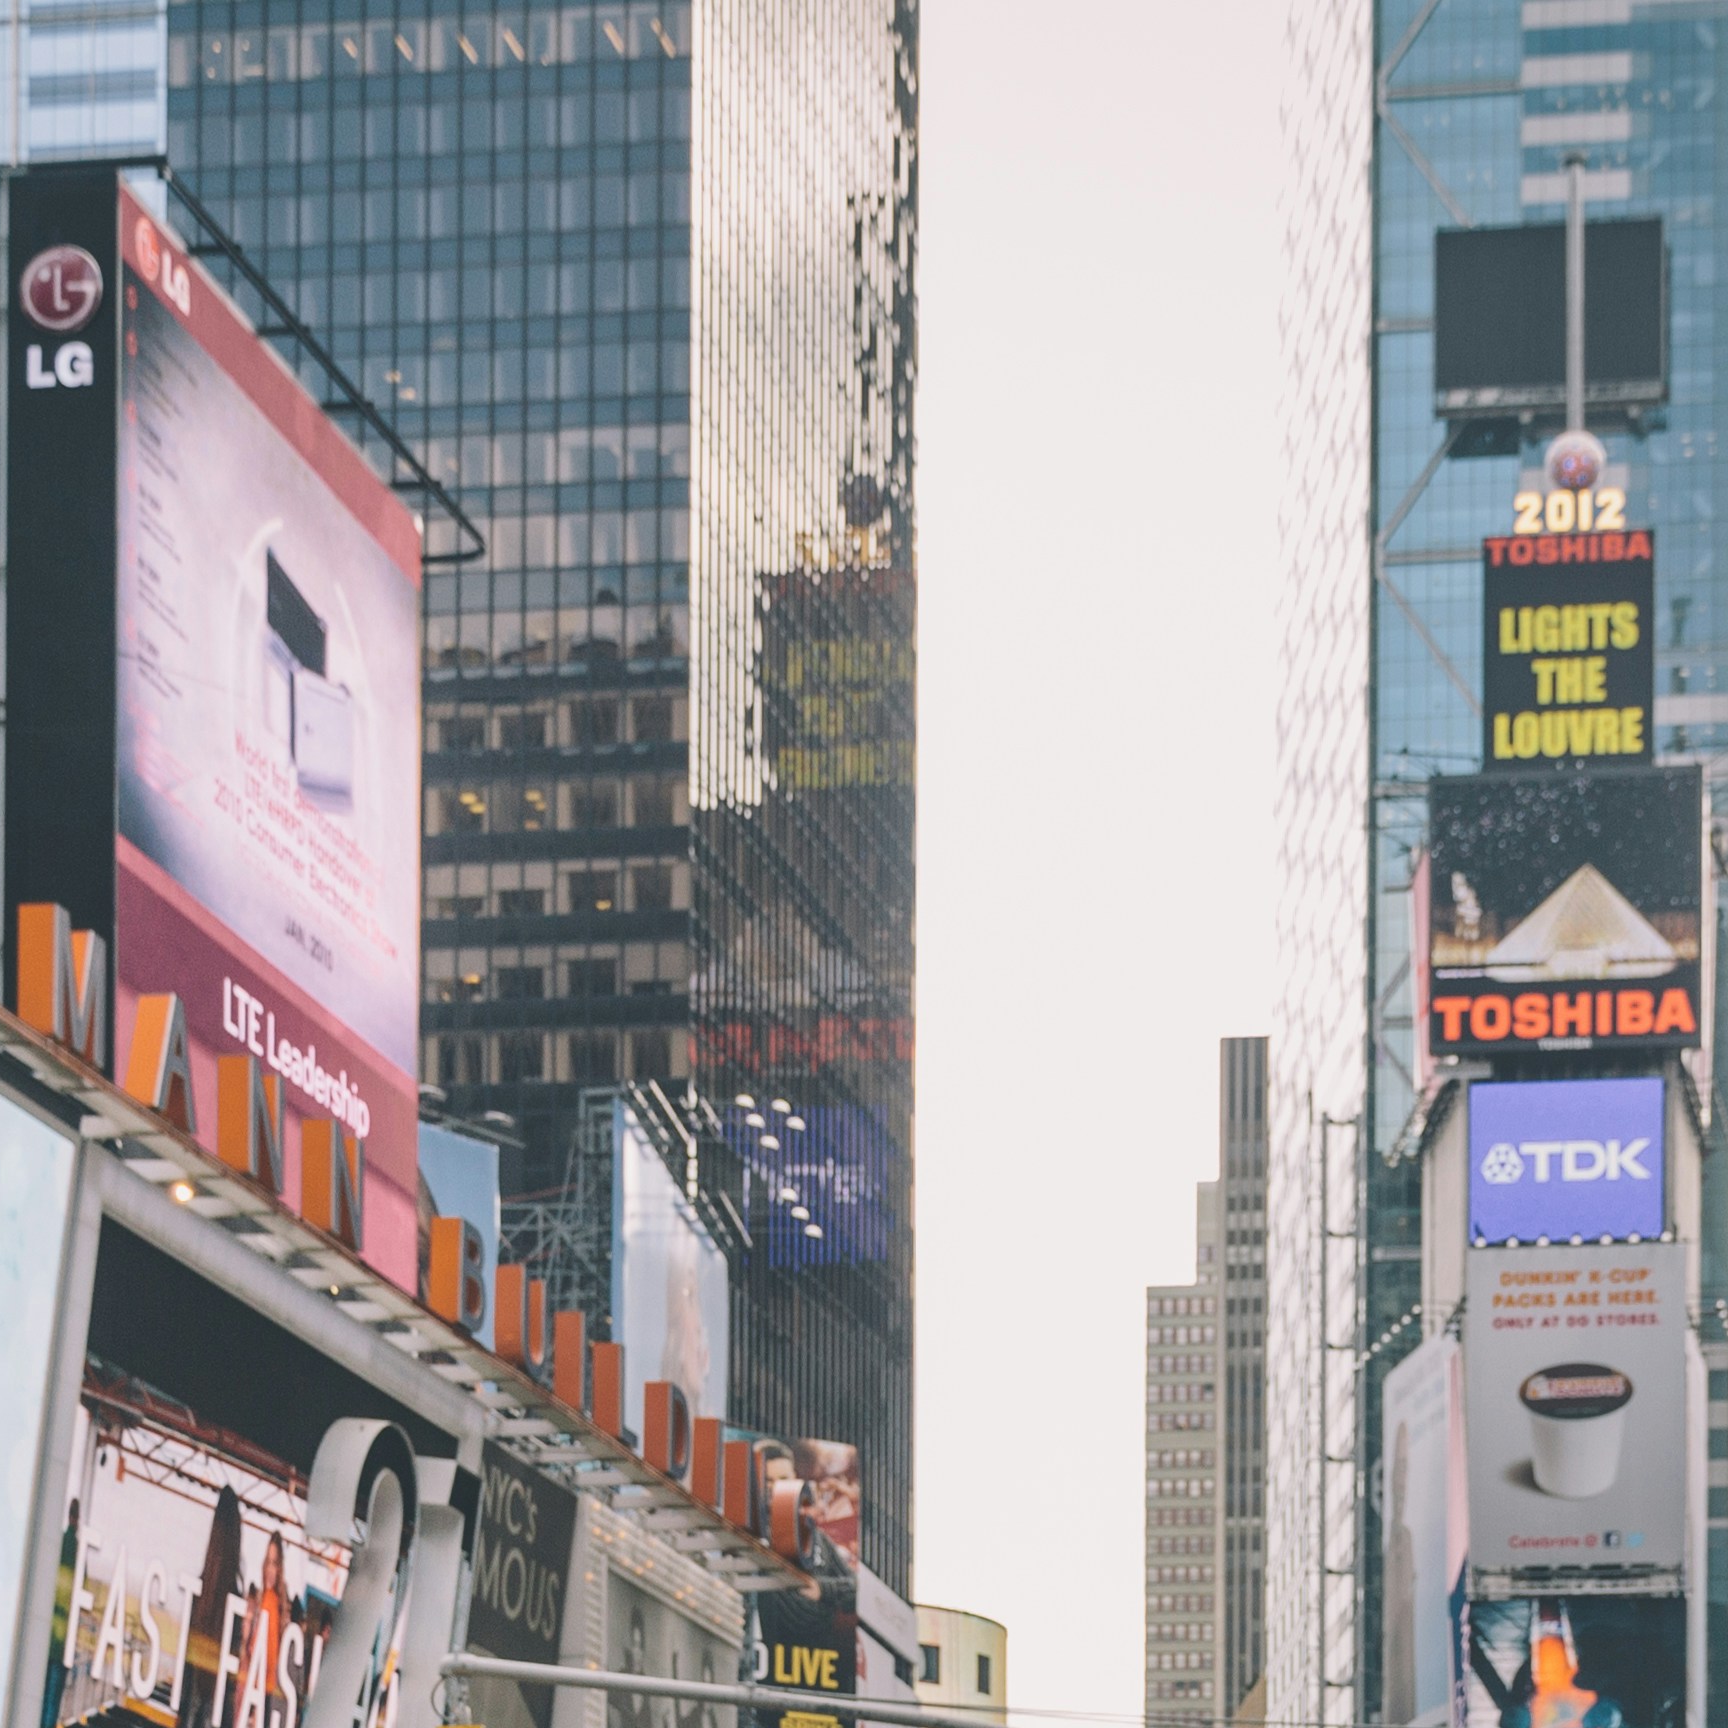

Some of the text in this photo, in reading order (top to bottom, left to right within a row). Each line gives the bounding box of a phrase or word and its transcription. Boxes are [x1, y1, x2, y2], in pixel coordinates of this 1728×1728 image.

[27, 341, 94, 389] LG
[1513, 488, 1626, 534] 2012
[1484, 531, 1652, 567] TOSHIBA
[1499, 601, 1640, 654] LIGHTS
[1531, 655, 1607, 705] THE
[1493, 707, 1644, 760] LOUVRE
[1433, 988, 1698, 1041] TOSHIBA
[223, 976, 371, 1141] LTE Leadership
[1519, 1138, 1654, 1183] TDK
[1564, 1291, 1600, 1307] ARE
[473, 1528, 560, 1641] MOUS
[62, 1523, 204, 1712] FAST
[774, 1644, 839, 1690] LIVE
